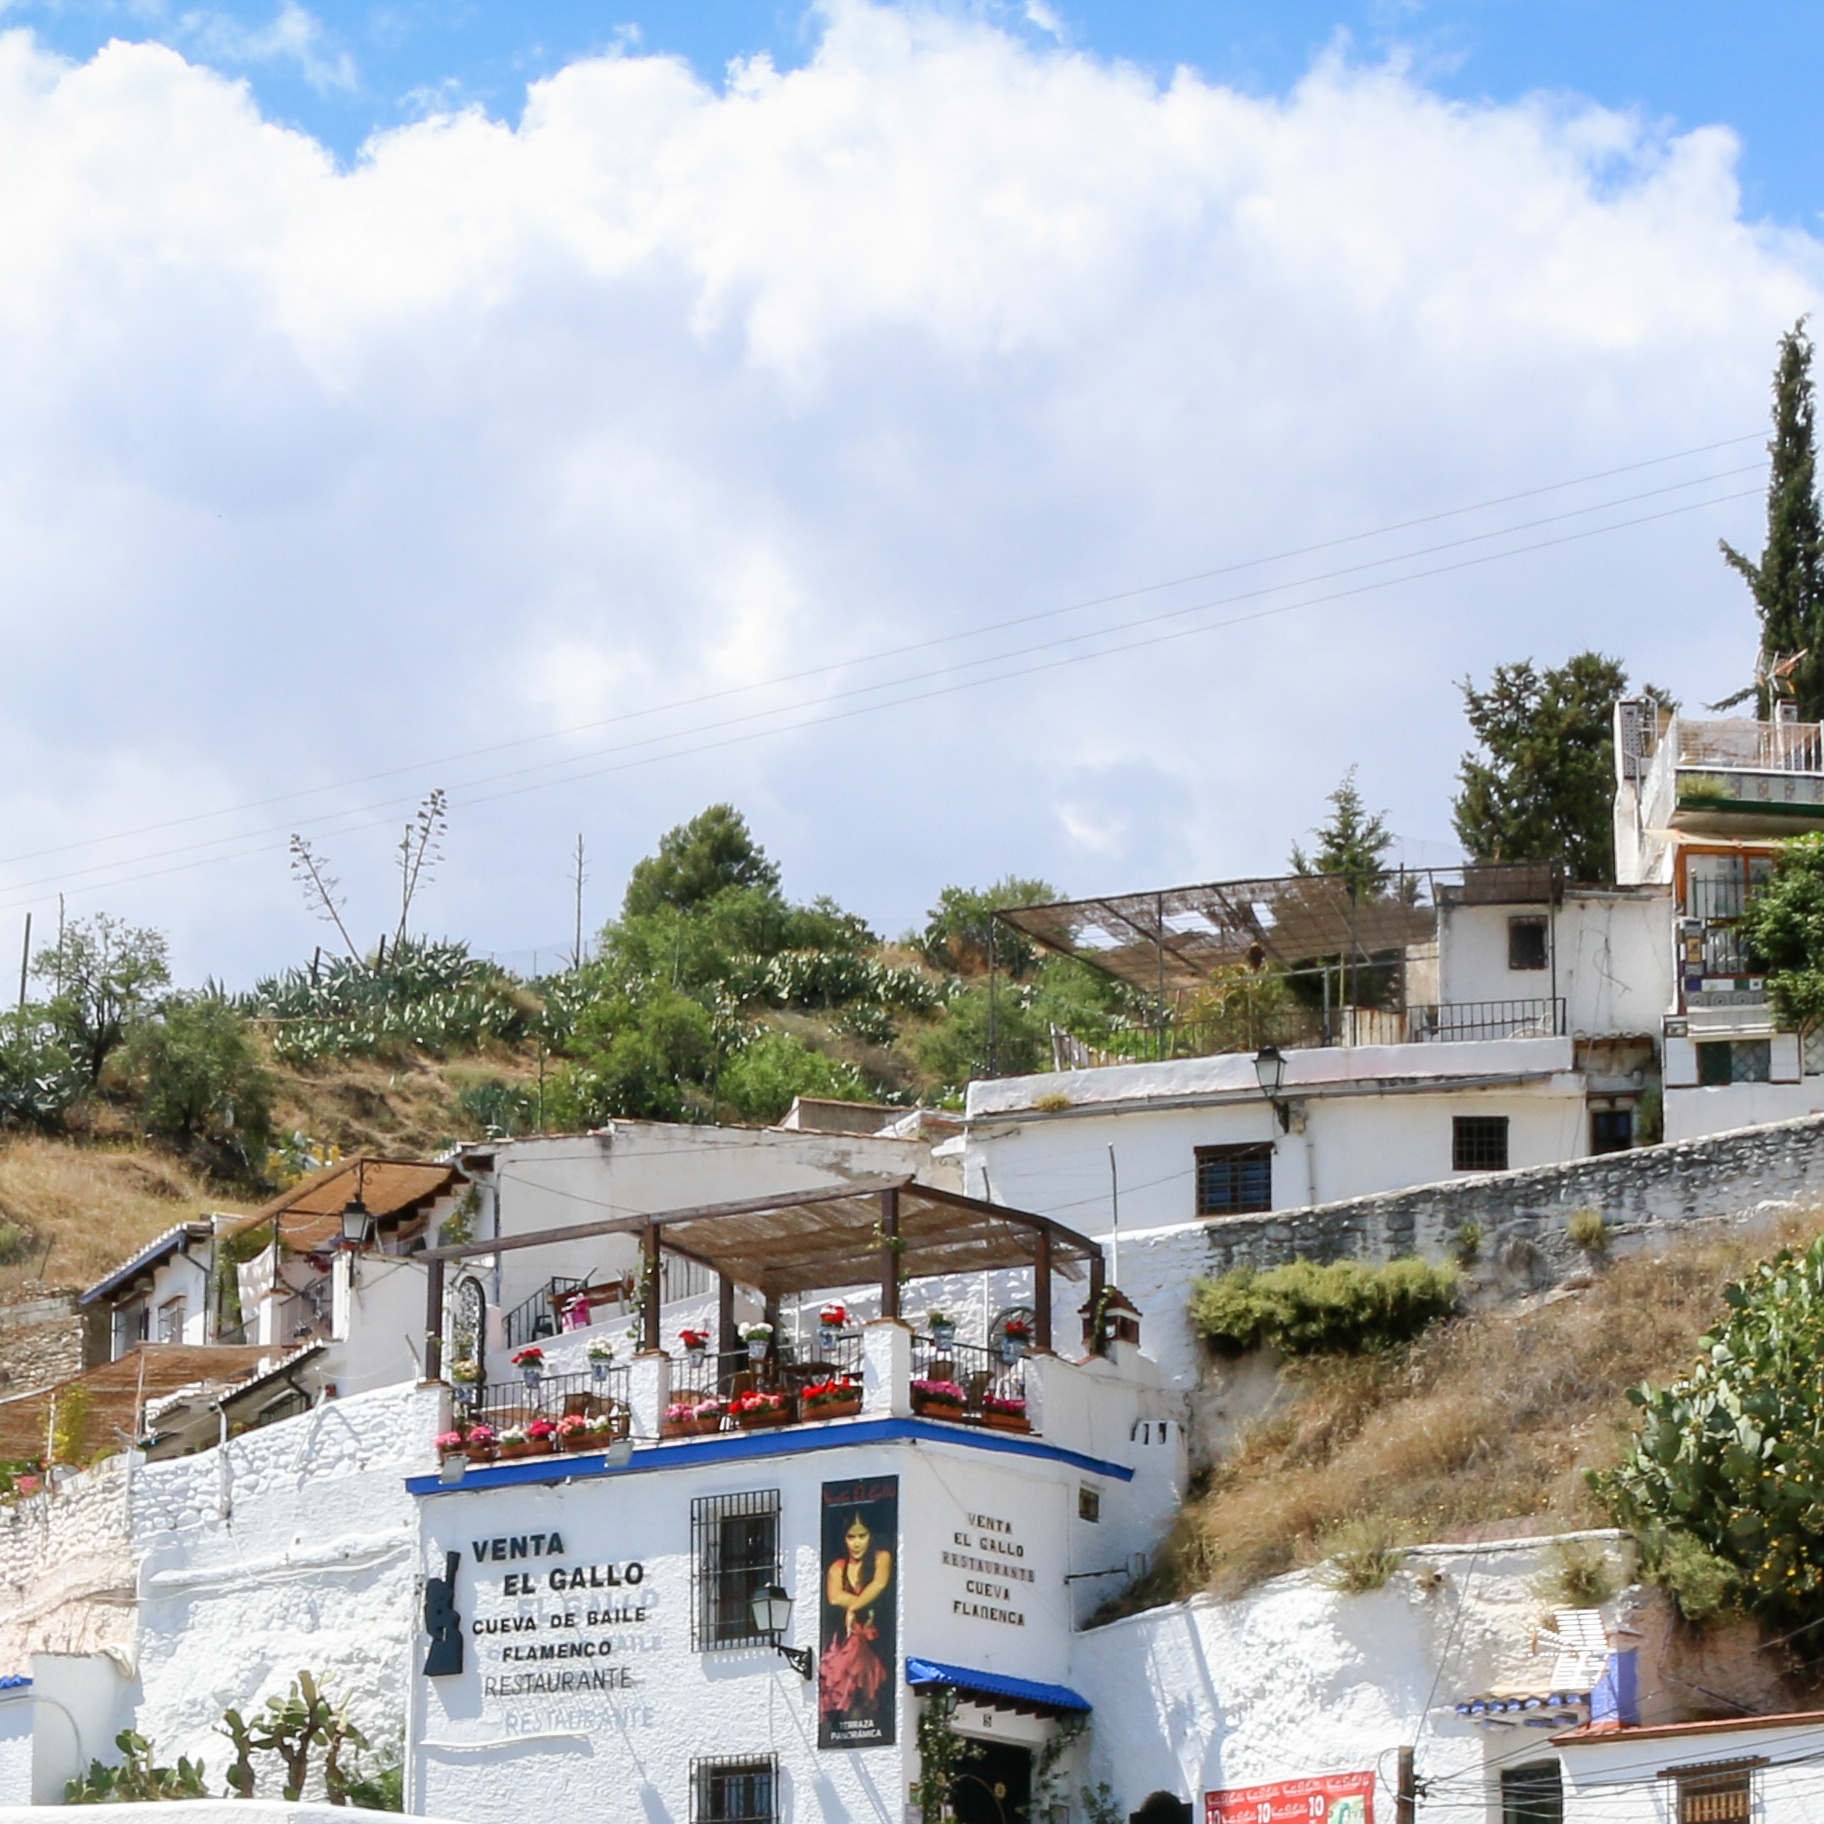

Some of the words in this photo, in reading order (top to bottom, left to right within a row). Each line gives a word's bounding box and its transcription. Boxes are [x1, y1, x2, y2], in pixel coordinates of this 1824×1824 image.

[968, 1512, 1012, 1534] VENTA
[472, 1532, 564, 1562] VENTA
[954, 1532, 971, 1547] EL
[979, 1537, 1024, 1557] GALLO
[503, 1572, 536, 1596] EL
[549, 1562, 644, 1591] GALLO
[942, 1551, 1035, 1582] RESTAURANTE
[966, 1580, 1010, 1600] CUEVA
[472, 1617, 536, 1635] CUEVA
[551, 1613, 575, 1629] DE
[587, 1607, 646, 1626] BAILE
[502, 1641, 612, 1662] FLAMENCO
[484, 1667, 632, 1697] RESTAURANTE
[1257, 1802, 1271, 1824] 10
[1308, 1795, 1324, 1817] 10
